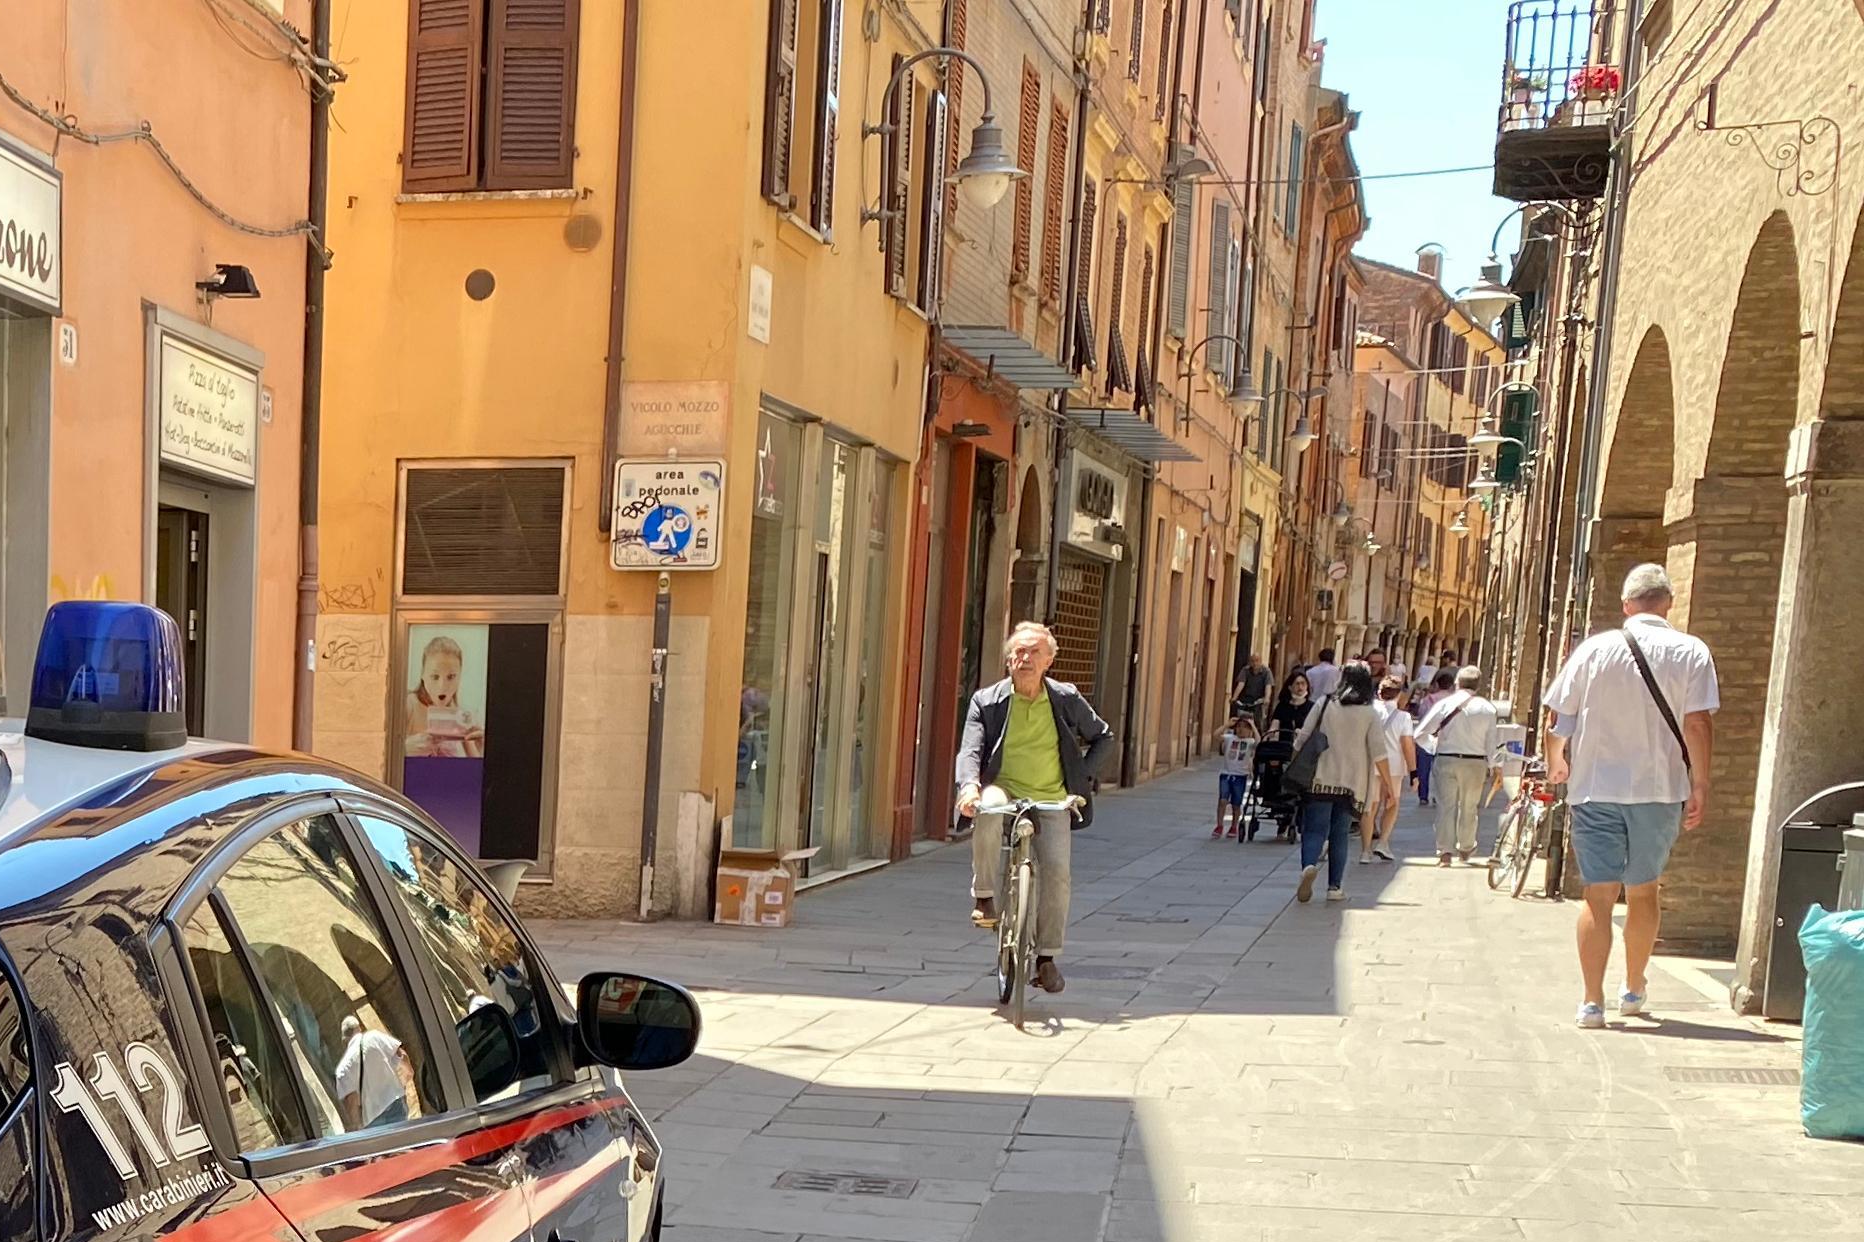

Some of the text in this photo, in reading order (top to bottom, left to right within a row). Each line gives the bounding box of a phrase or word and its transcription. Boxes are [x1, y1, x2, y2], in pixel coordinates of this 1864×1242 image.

[630, 400, 720, 413] VICOLO MOZZO
[655, 470, 685, 480] area
[638, 485, 700, 498] pedonale
[49, 1040, 213, 1181] 112
[91, 1162, 231, 1232] www.carabinieri.it
